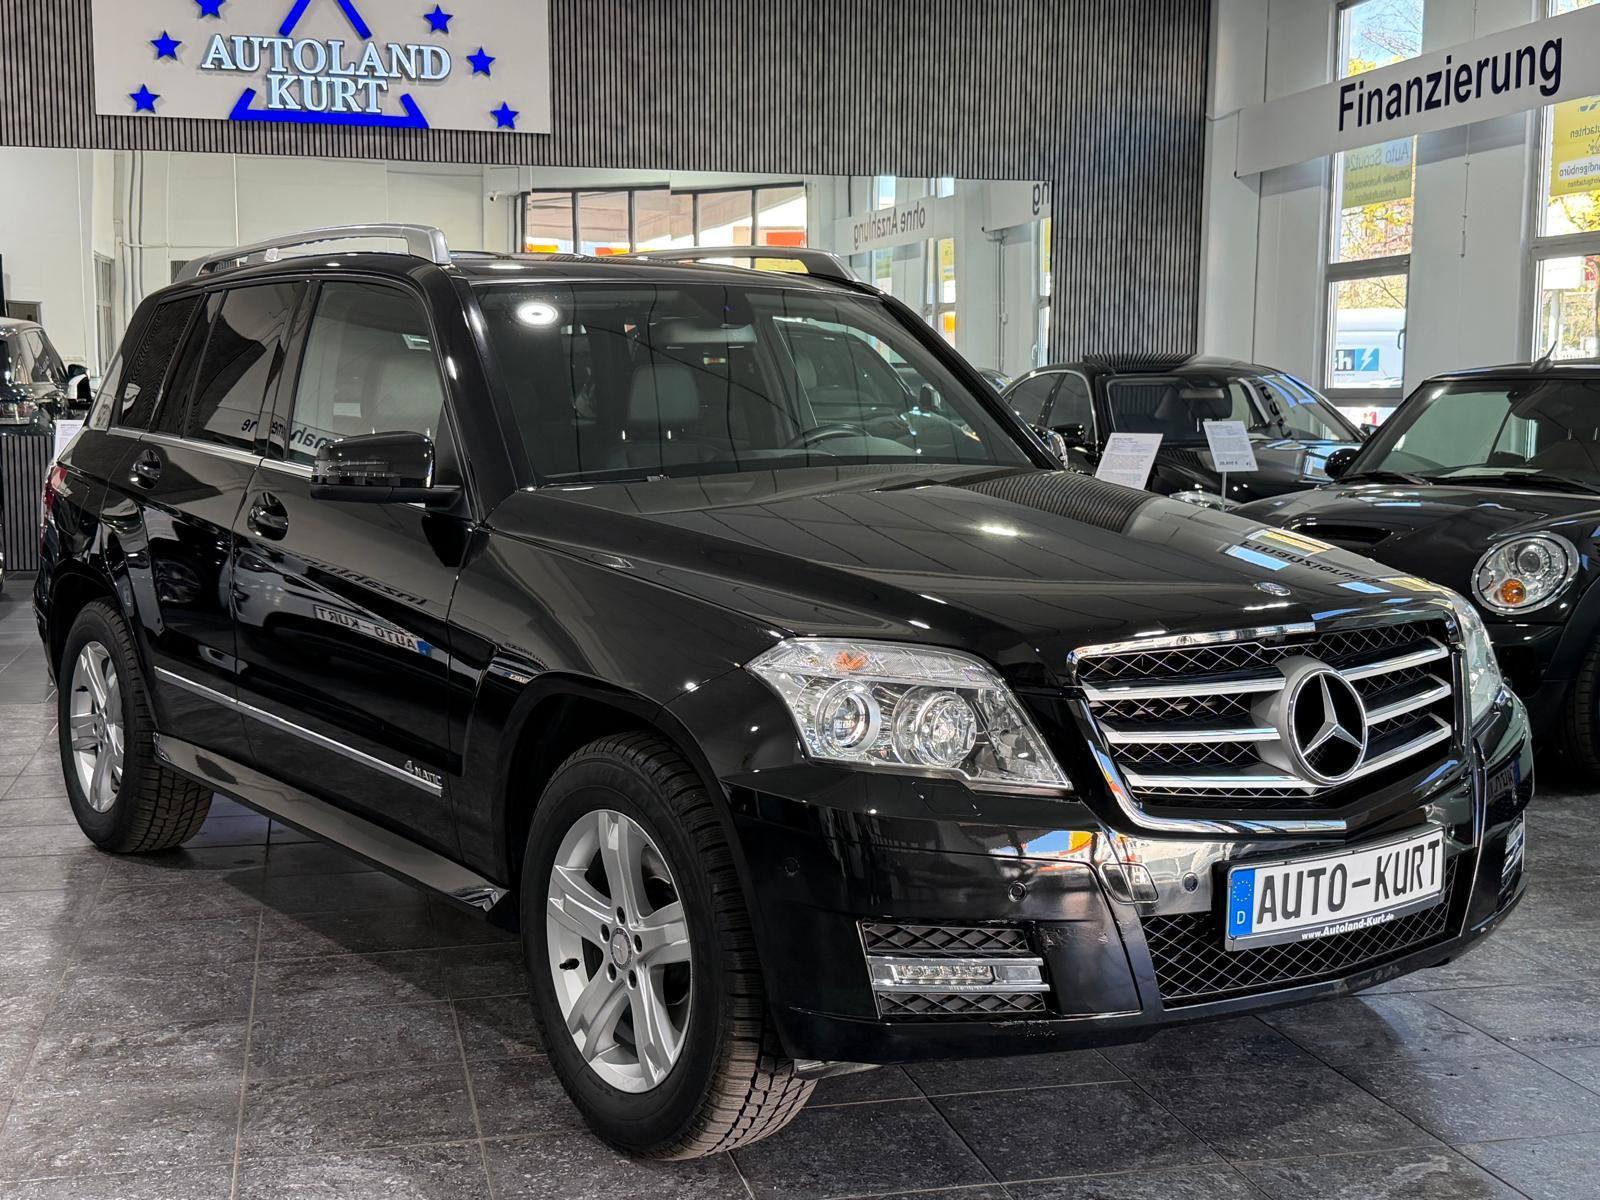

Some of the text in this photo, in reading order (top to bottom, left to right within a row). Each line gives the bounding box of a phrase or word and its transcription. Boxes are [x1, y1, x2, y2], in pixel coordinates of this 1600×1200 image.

[201, 34, 451, 80] AUTOLAND
[267, 74, 388, 113] KURT
[1338, 37, 1563, 132] Finanzierung
[1236, 838, 1440, 925] D AUTO-KURT
[1301, 912, 1395, 940] www.Autoland-Kurt.de
